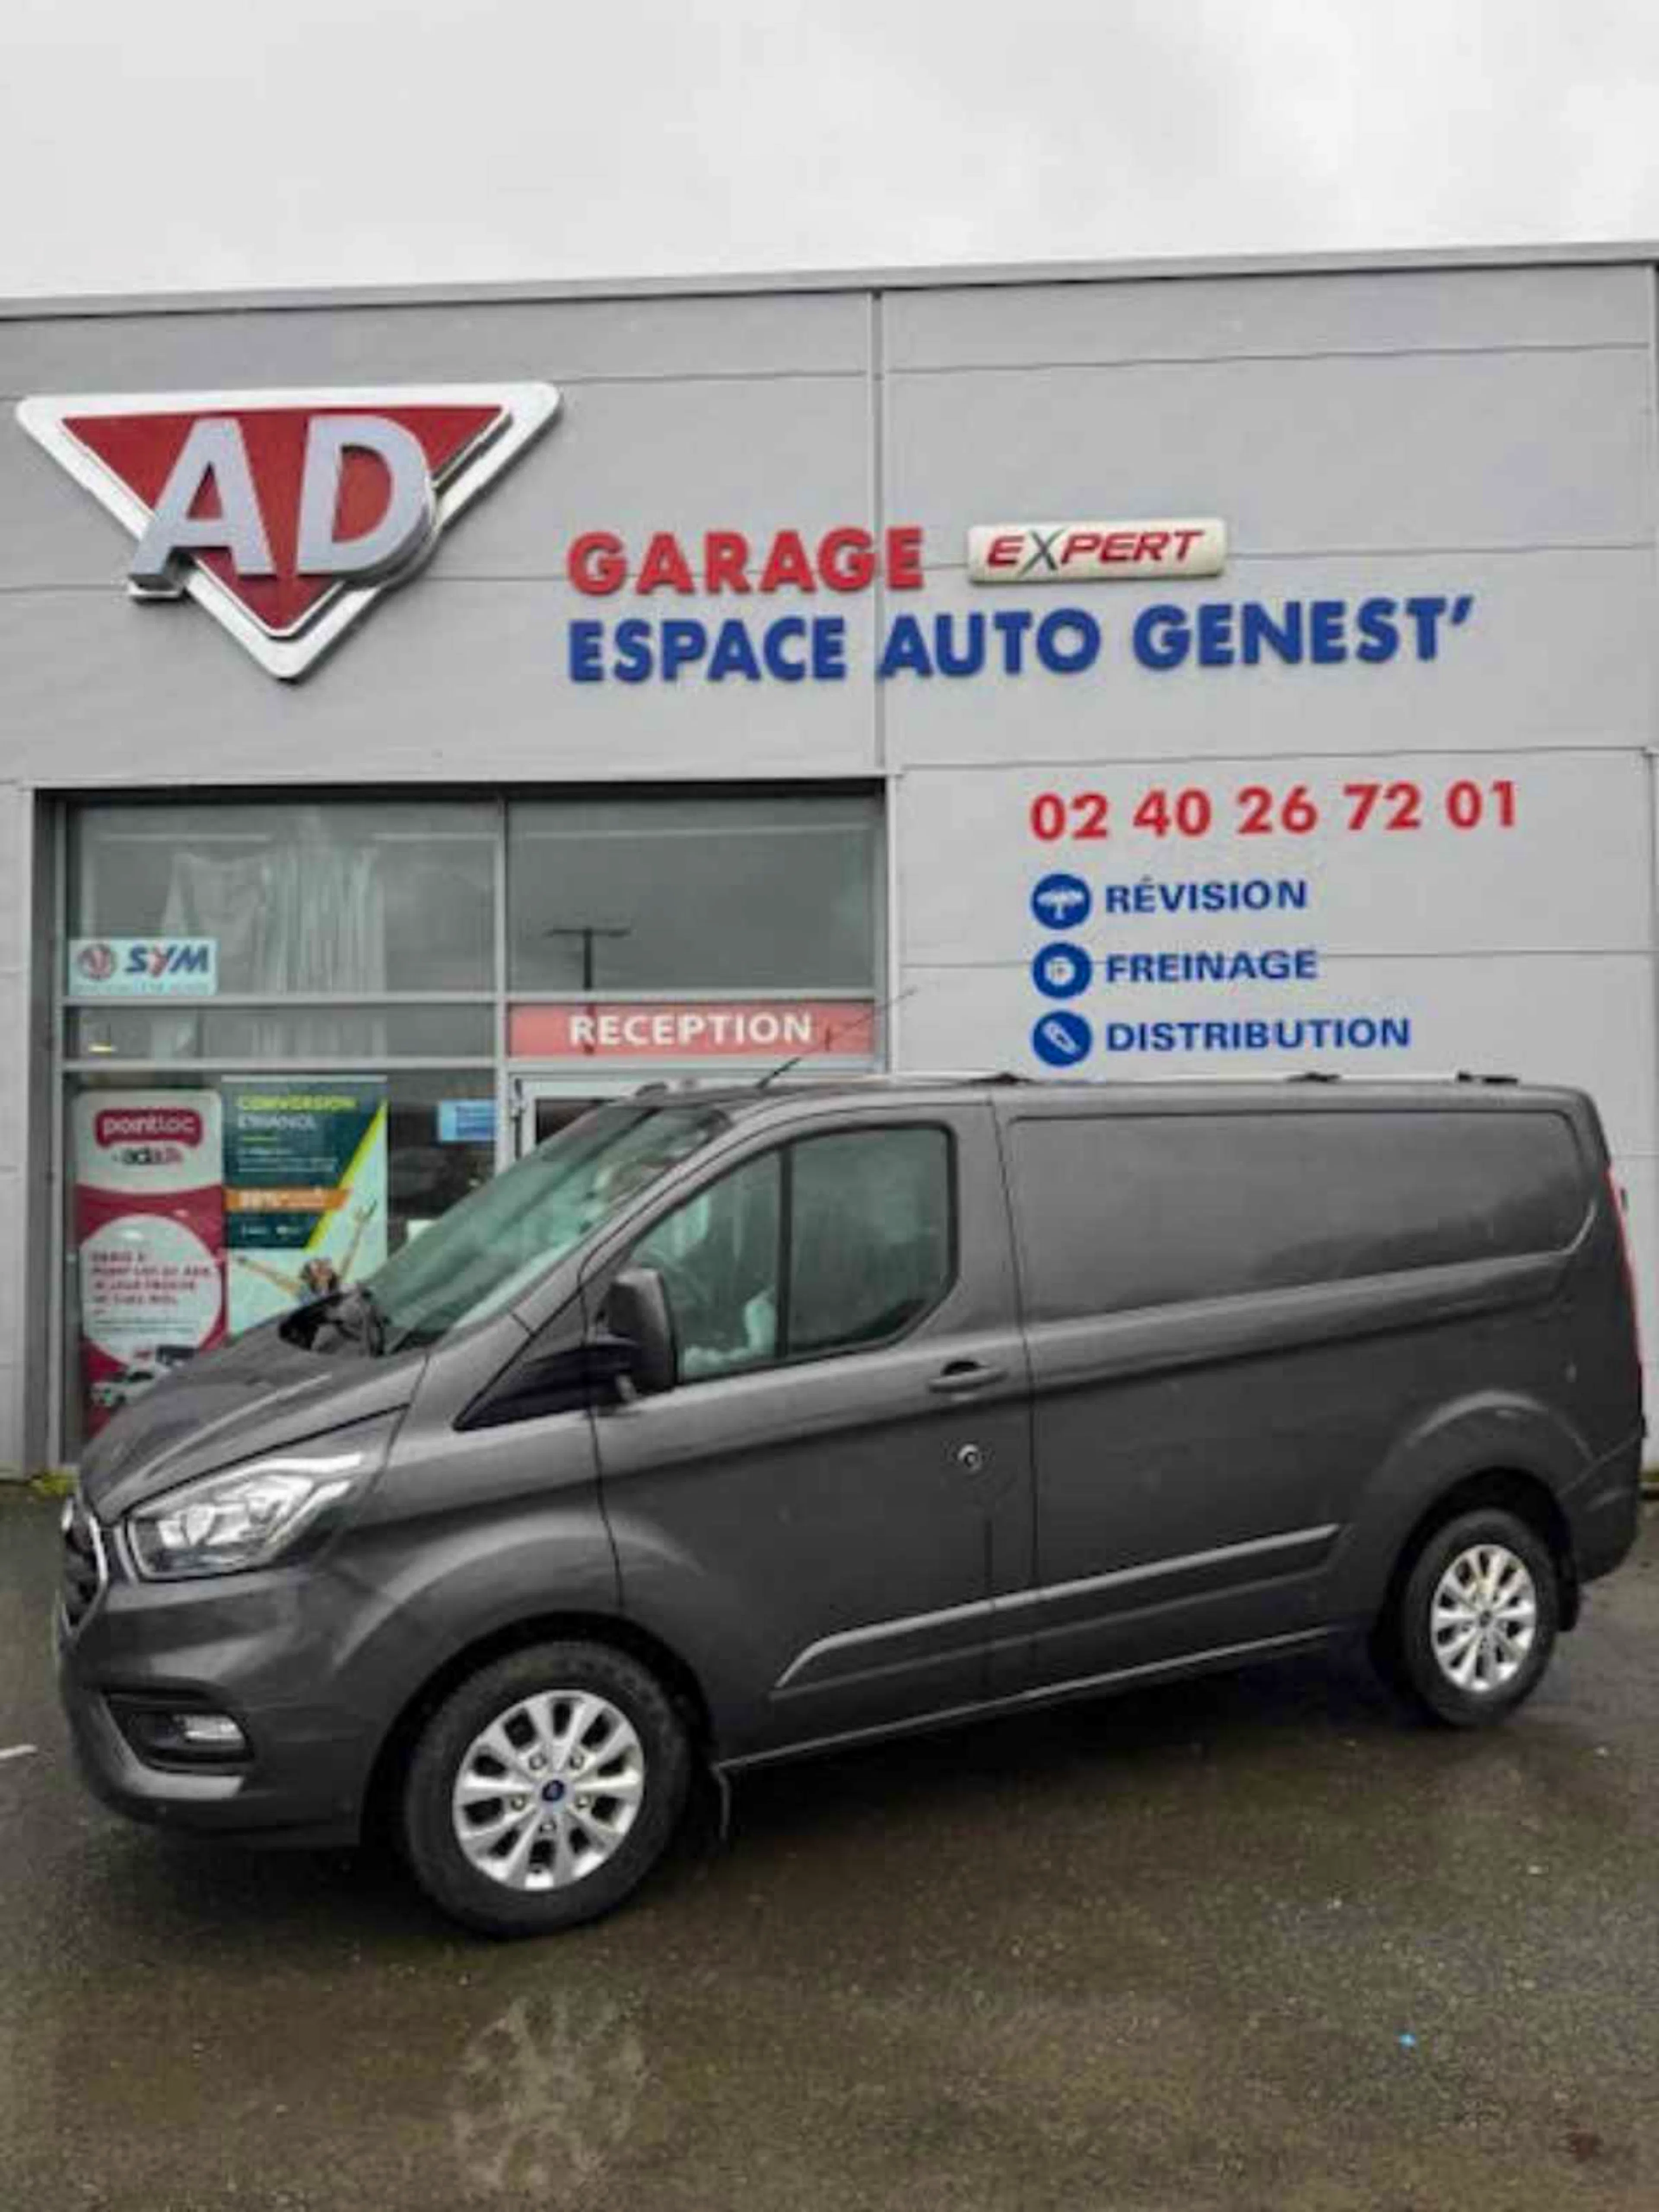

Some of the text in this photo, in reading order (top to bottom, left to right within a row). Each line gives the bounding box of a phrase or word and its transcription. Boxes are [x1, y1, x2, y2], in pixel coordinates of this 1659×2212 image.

[130, 414, 435, 581] AD
[568, 526, 924, 595] GARAGE
[987, 529, 1204, 577] EXPERT
[568, 615, 847, 683] ESPACE
[877, 607, 1101, 678] AUTO
[1030, 780, 1516, 841] 02 40 26 72 01
[1105, 874, 1307, 913] RÉVISION
[124, 943, 209, 977] SYM
[1105, 950, 1318, 983] FREINAGE
[568, 1013, 813, 1046] RECEPTION
[1105, 1017, 1411, 1052] DISTRIBUTION
